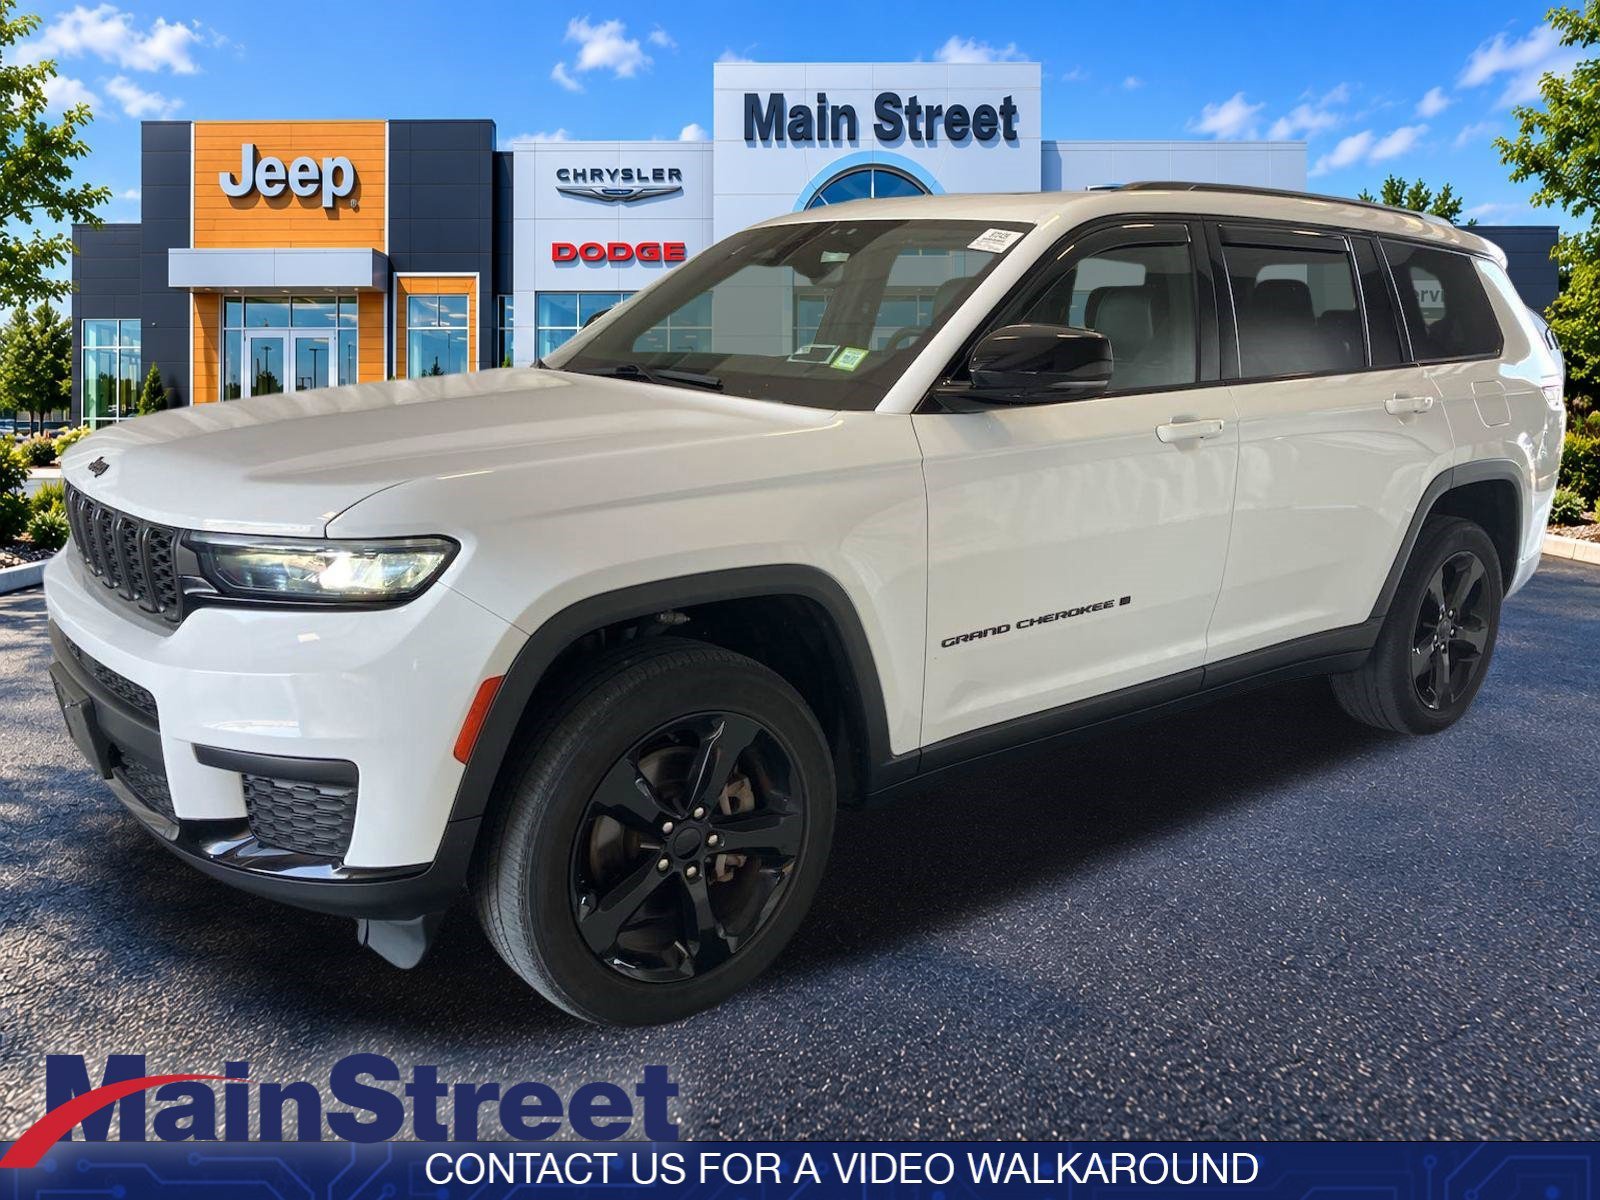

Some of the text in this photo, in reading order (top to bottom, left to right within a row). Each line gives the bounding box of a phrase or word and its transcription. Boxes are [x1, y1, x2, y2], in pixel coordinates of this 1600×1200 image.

[743, 92, 1018, 141] Main Street
[218, 143, 354, 208] Jeep
[556, 168, 683, 182] CHRYSLER
[551, 242, 687, 262] DODGE
[941, 599, 1115, 648] GRAND CHEROKEE
